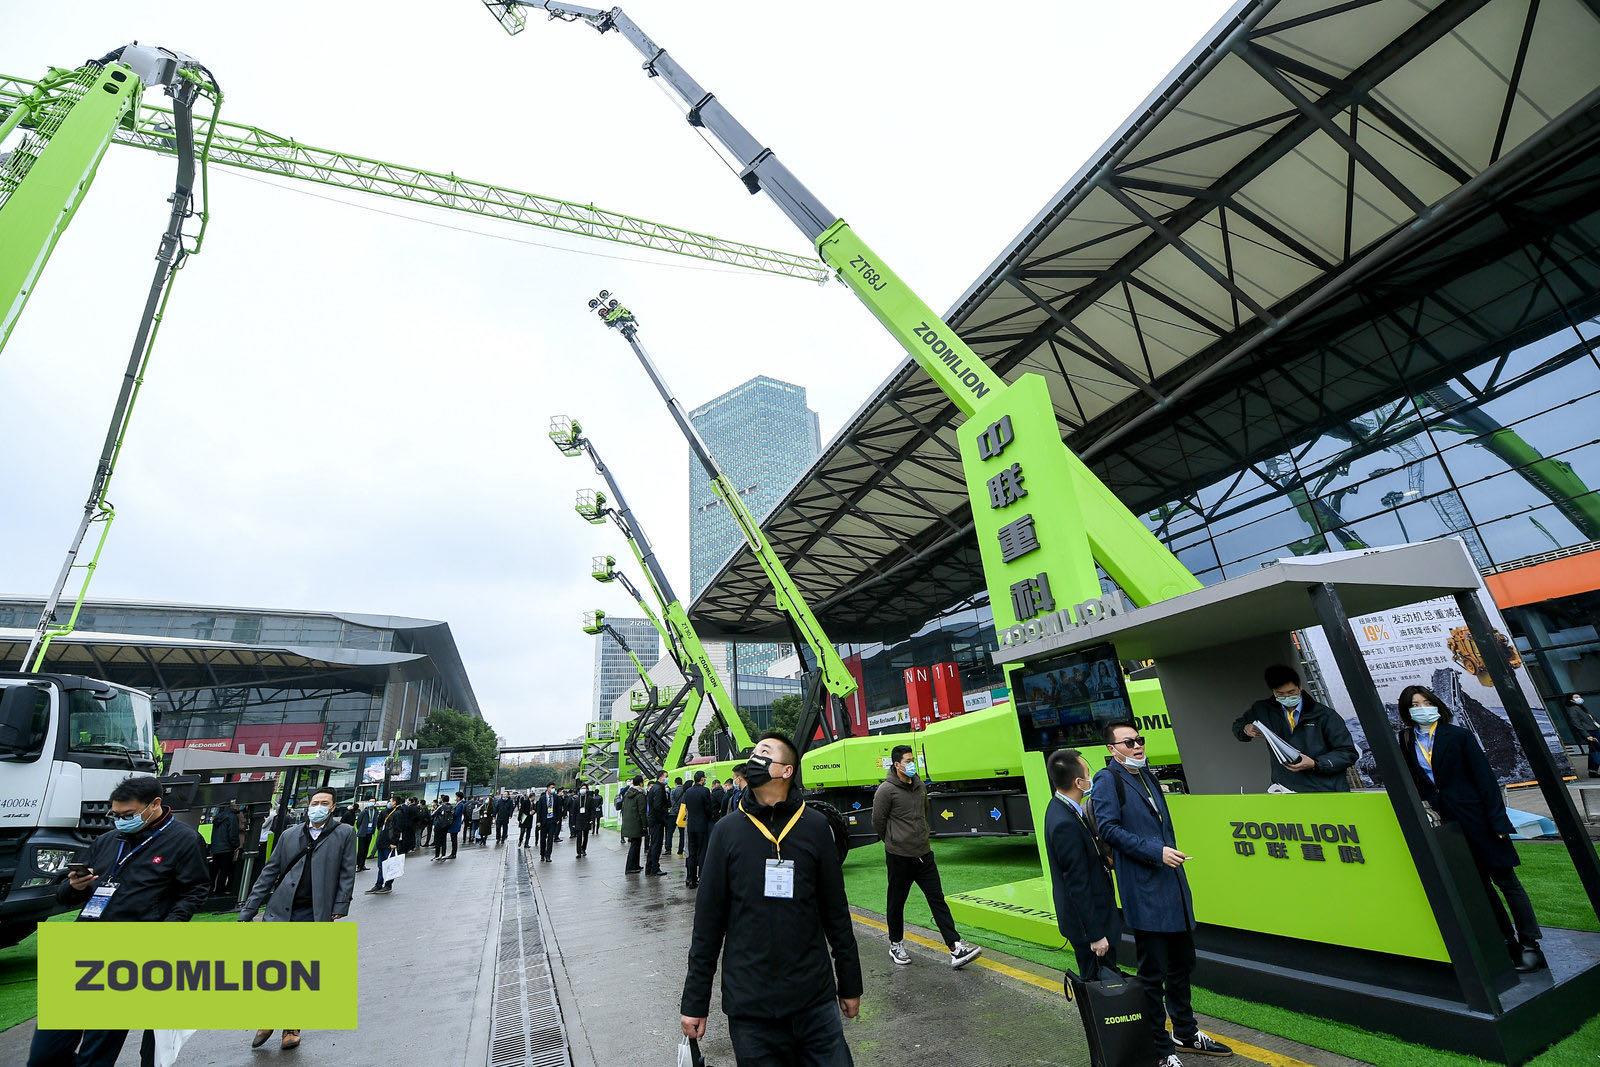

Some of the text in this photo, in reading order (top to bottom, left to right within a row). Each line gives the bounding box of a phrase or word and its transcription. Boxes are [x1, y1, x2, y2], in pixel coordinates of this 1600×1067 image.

[850, 255, 887, 292] ZT68J
[913, 321, 991, 399] ZOOMLION
[976, 414, 1056, 621] 中联重科
[999, 590, 1125, 648] ZOOMLION
[1362, 624, 1390, 642] 19%
[698, 655, 718, 688] ZOOMLION
[916, 669, 928, 682] N
[326, 739, 418, 754] ZOOMLION
[813, 763, 841, 771] ZOOMLION
[0, 798, 38, 809] 4000kg
[1230, 821, 1360, 844] ZOOMLION
[1104, 1013, 1142, 1025] ZOOMLION
